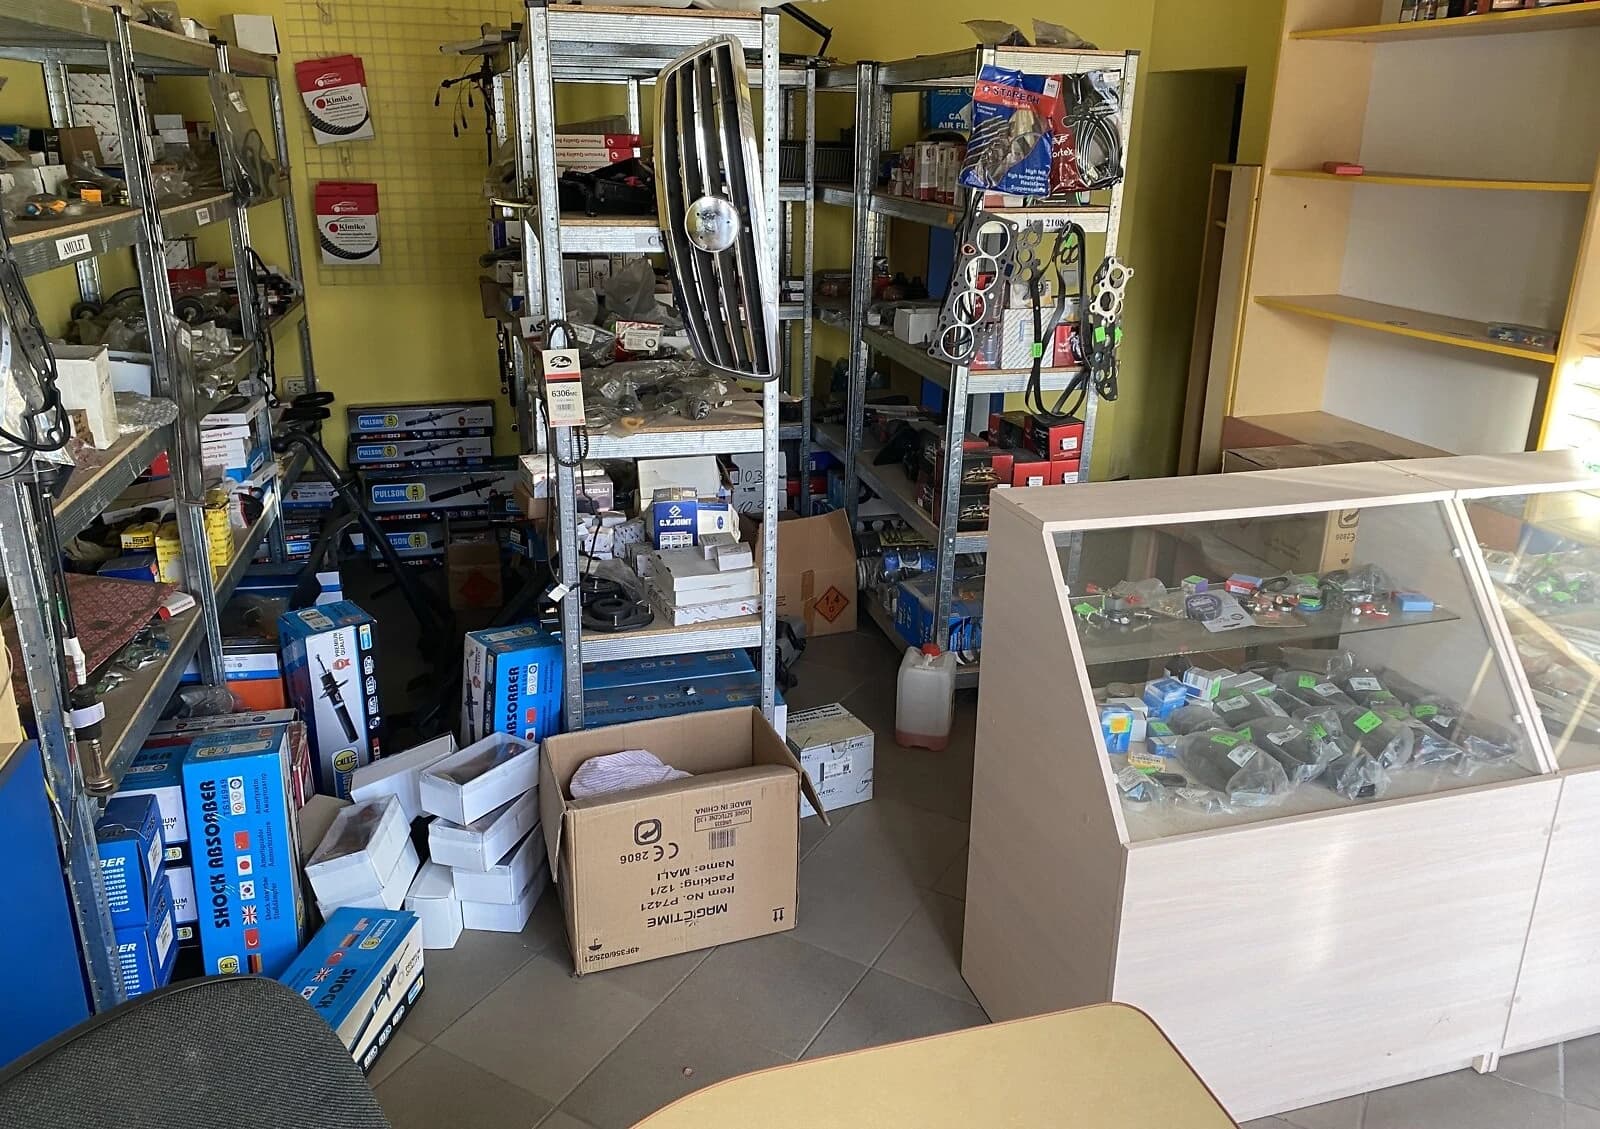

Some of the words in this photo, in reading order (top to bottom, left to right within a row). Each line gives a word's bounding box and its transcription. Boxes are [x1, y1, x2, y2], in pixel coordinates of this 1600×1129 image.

[325, 95, 353, 105] Kimiko
[938, 121, 954, 129] AIR
[1052, 147, 1073, 158] ortex
[339, 223, 366, 231] Kimiko
[63, 238, 86, 255] AMULET
[374, 488, 405, 499] PULLSON
[331, 632, 340, 657] PREMIUM
[695, 805, 720, 815] CHINA
[720, 803, 729, 811] IN
[730, 800, 752, 809] MADE
[200, 779, 226, 869] ABSORBER
[100, 856, 126, 868] BER
[619, 851, 649, 864] 2806
[695, 859, 735, 872] Name:
[656, 867, 690, 881] MALI
[680, 872, 735, 889] Packing:
[649, 884, 675, 896] 12/1
[683, 892, 704, 900] No.
[707, 885, 735, 896] Item
[209, 873, 231, 929] SHOCK
[640, 897, 679, 912] P7421
[646, 902, 728, 928] MAGICTIME
[316, 968, 357, 1009] SHOCK
